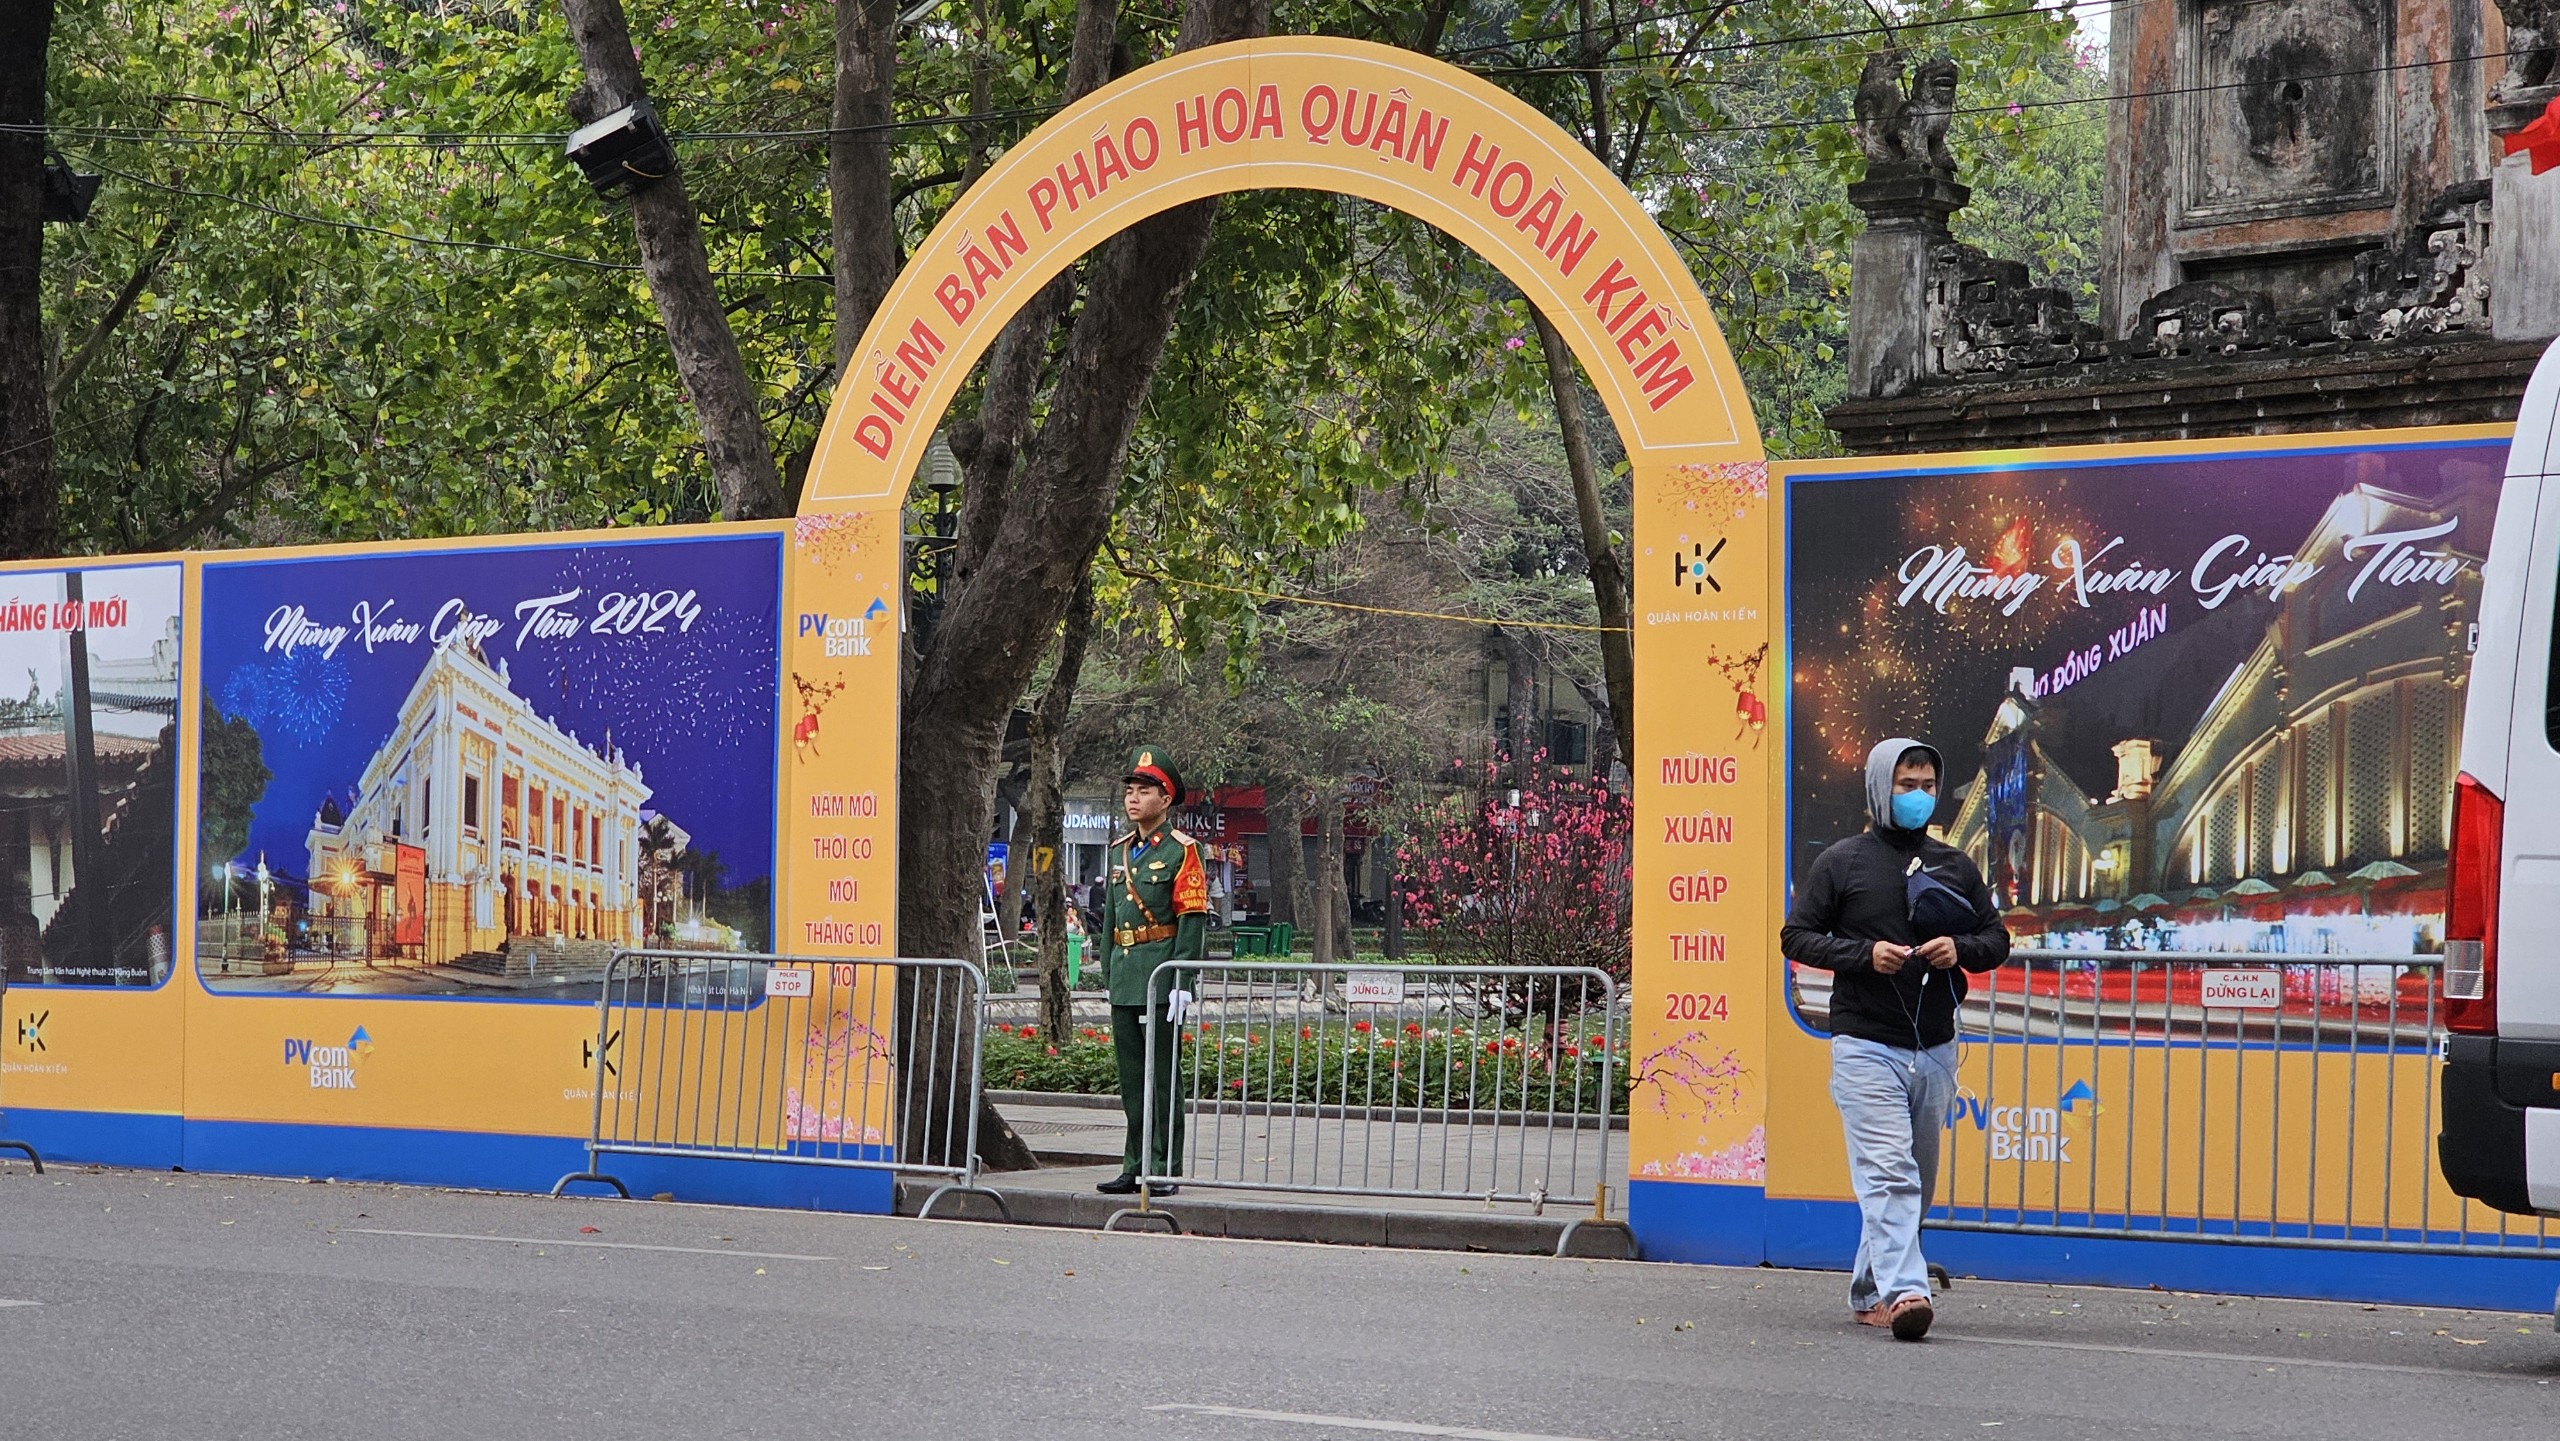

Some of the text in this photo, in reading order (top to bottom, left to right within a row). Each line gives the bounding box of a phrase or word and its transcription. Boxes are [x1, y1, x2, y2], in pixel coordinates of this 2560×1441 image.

[852, 84, 1697, 462] ĐIỂM BẮN PHÁO HOA QUẬN HOÀN KIẾM
[2051, 536, 2182, 608] Xuân
[88, 594, 128, 629] MỚI
[352, 598, 425, 654] Xuân
[590, 589, 702, 635] 2024
[1647, 606, 1757, 625] QUẬN HOÀN KIẾM
[825, 636, 873, 657] Bank
[2108, 603, 2167, 662] XUÂN
[1664, 809, 1733, 844] XUÂN
[1668, 870, 1728, 903] GIÁP
[1669, 929, 1726, 962] THÌN
[775, 981, 801, 991] STOP
[2206, 983, 2275, 1001] DỪNG LẠI
[1665, 993, 1729, 1022] 2024
[310, 1066, 357, 1088] Bank
[1991, 1132, 2071, 1162] Bank
